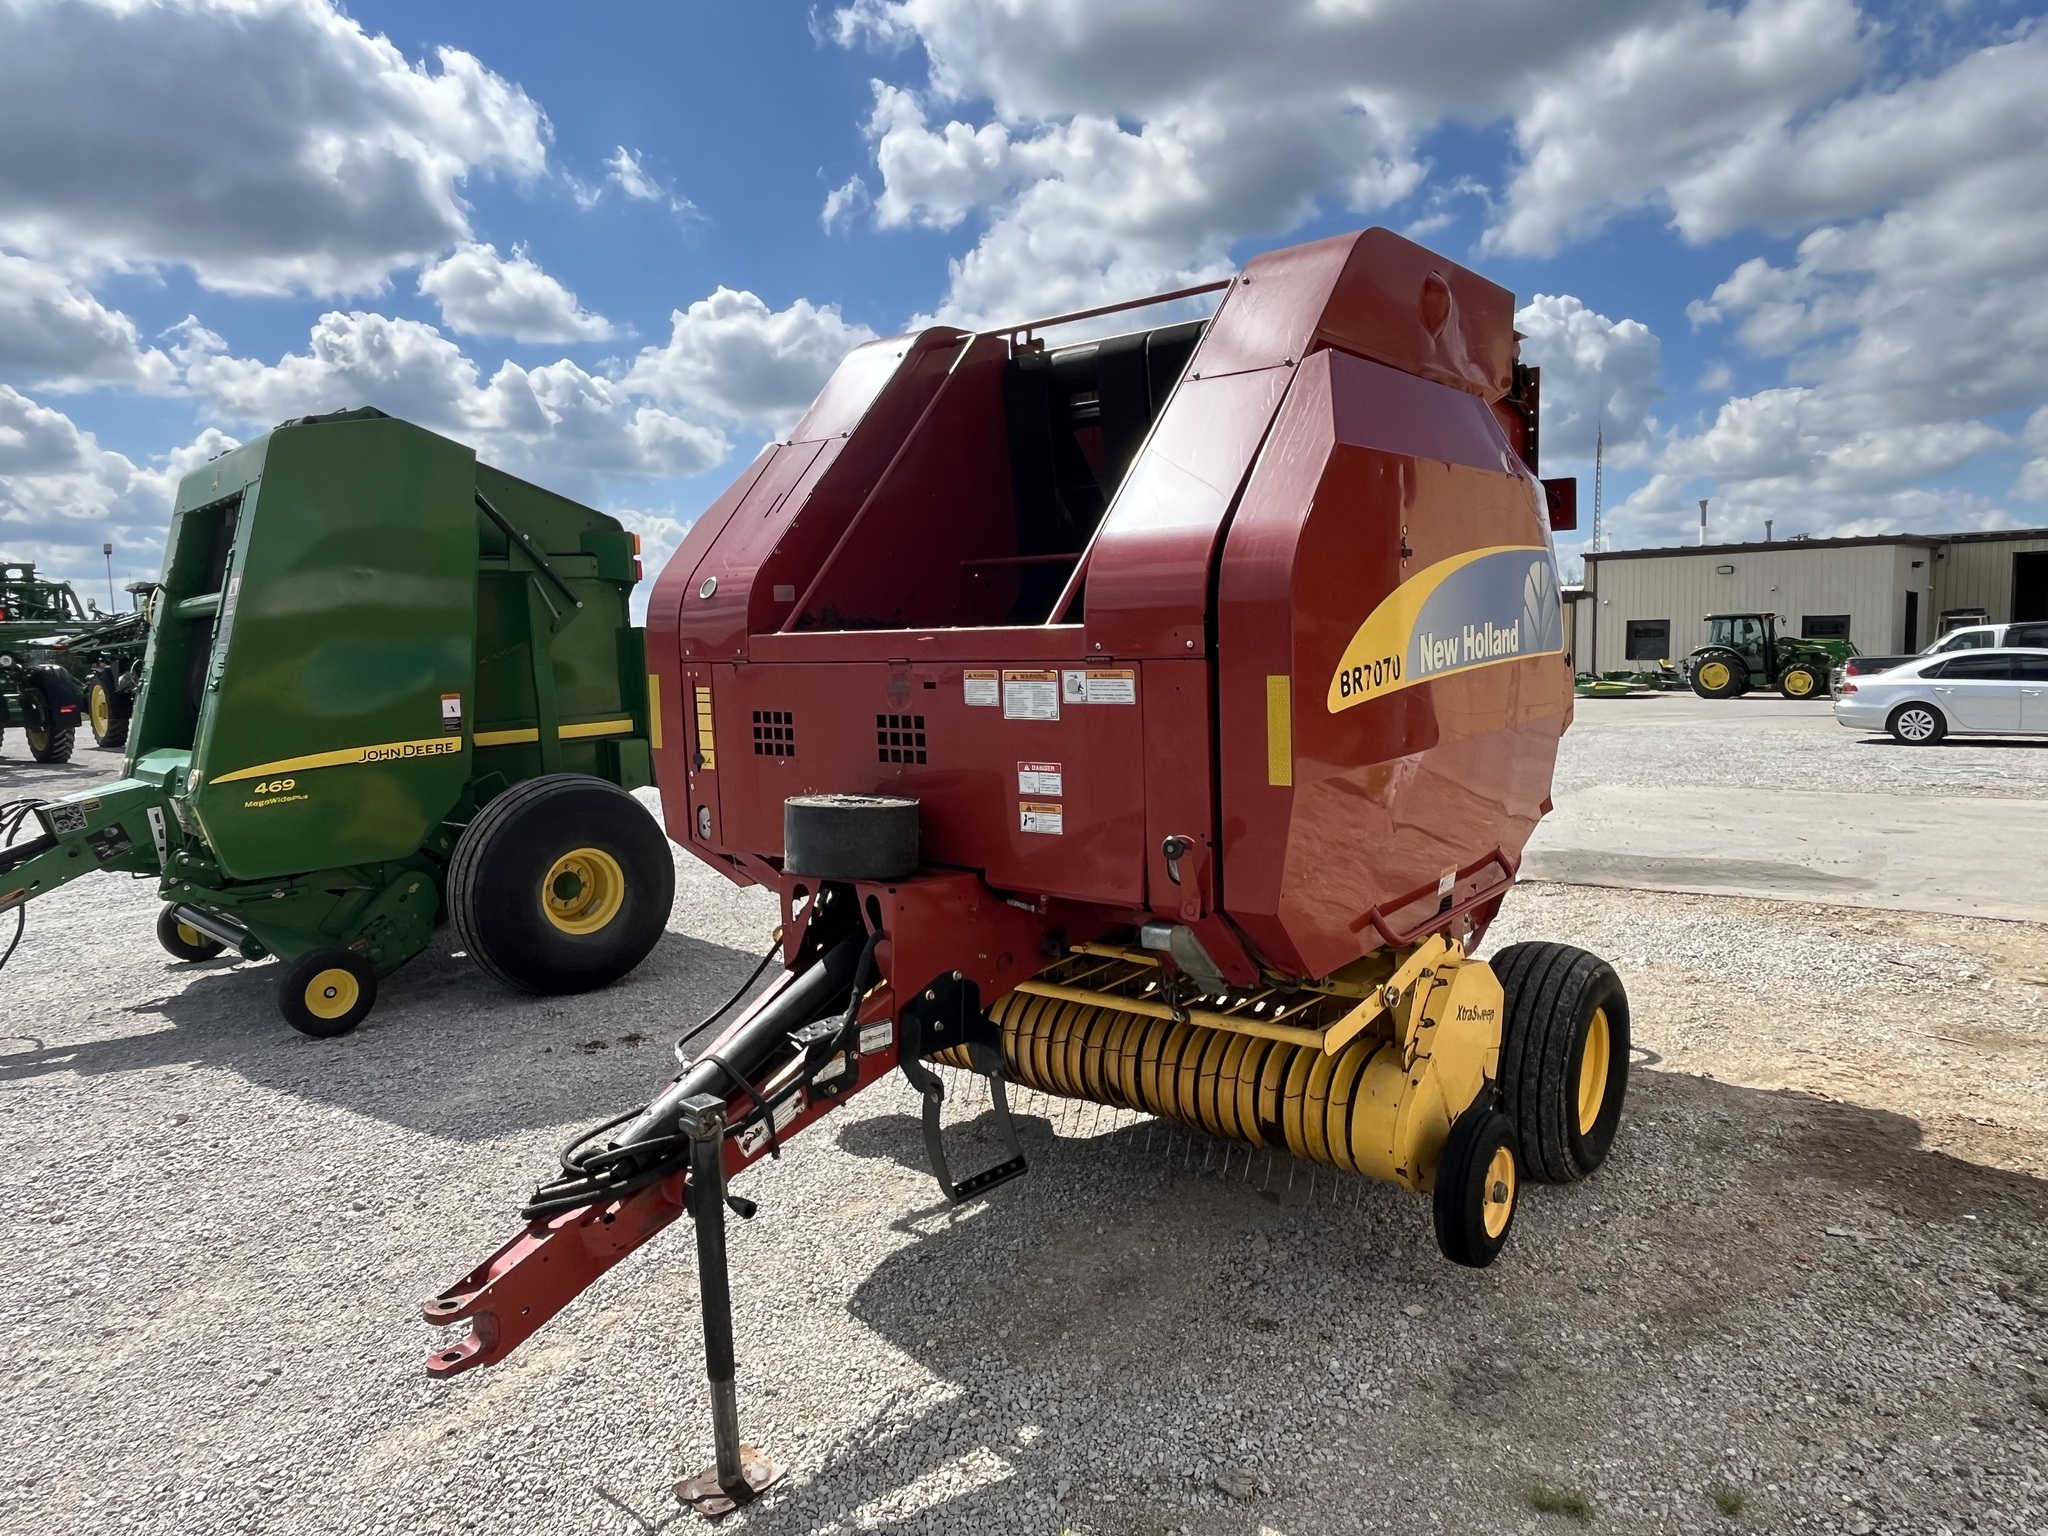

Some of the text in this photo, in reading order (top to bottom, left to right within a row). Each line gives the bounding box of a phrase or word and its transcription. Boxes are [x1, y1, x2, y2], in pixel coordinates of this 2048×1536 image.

[1419, 619, 1519, 673] New Holland
[1340, 654, 1401, 698] BR7070
[358, 742, 454, 763] JOHN DEERE
[254, 778, 296, 794] 469
